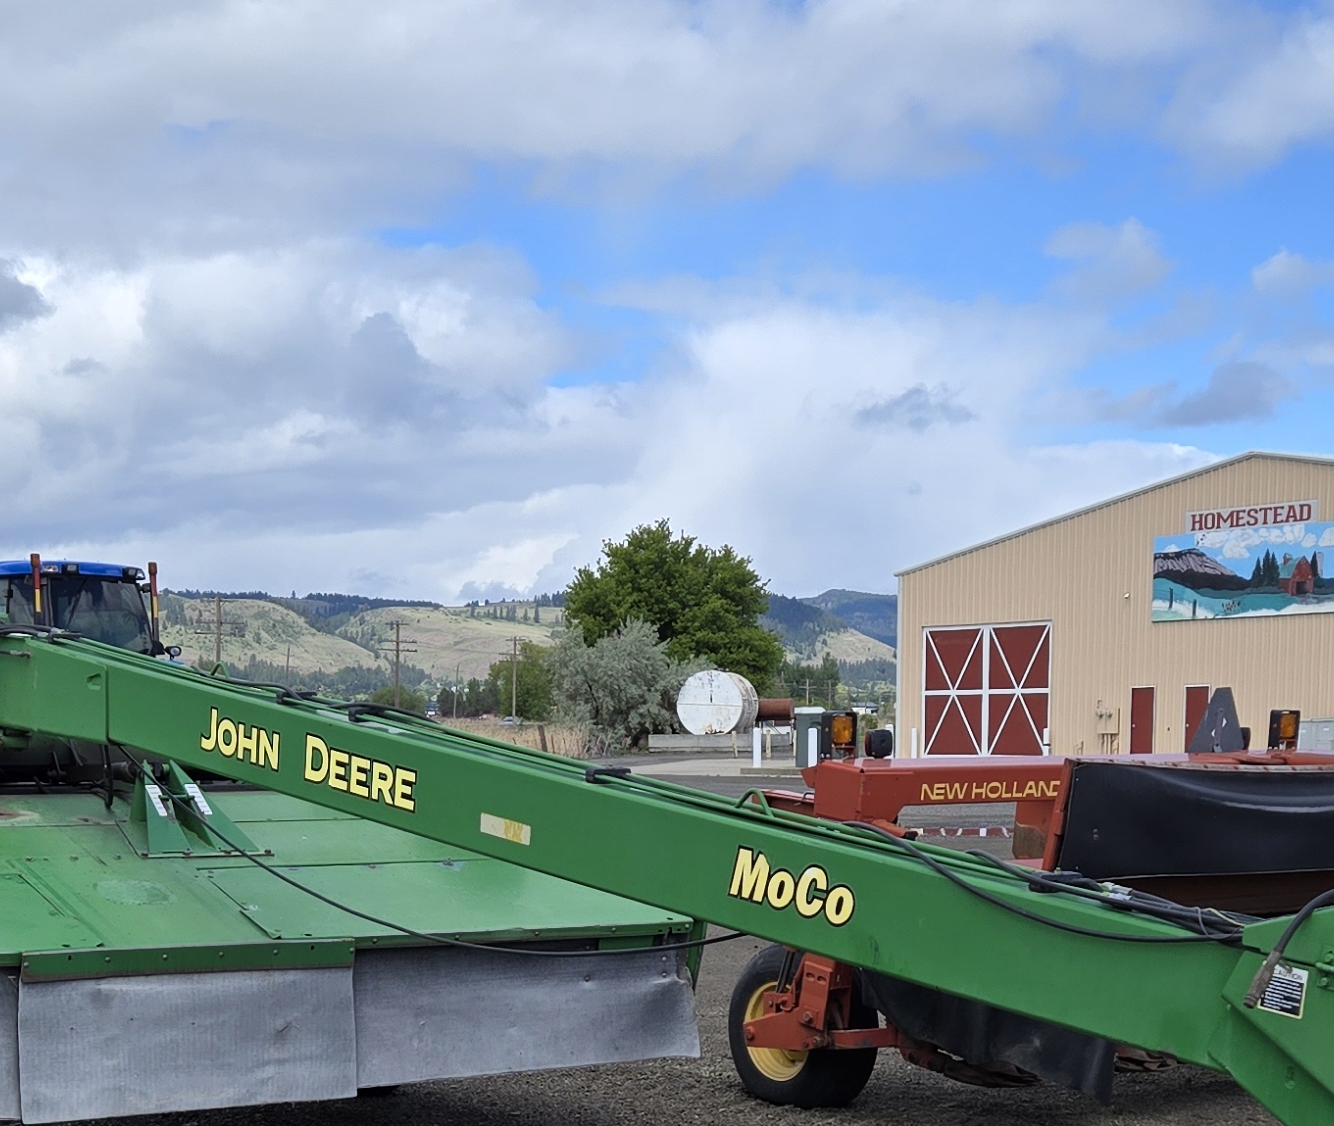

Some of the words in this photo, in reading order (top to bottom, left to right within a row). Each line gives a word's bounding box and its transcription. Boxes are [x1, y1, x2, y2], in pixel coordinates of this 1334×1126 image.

[1190, 503, 1312, 532] HOMESTEAD
[200, 706, 280, 772] JOHN
[304, 732, 416, 813] DEERE
[920, 782, 969, 801] NEW
[971, 780, 1061, 799] HOLLAND
[728, 845, 855, 928] MoCo
